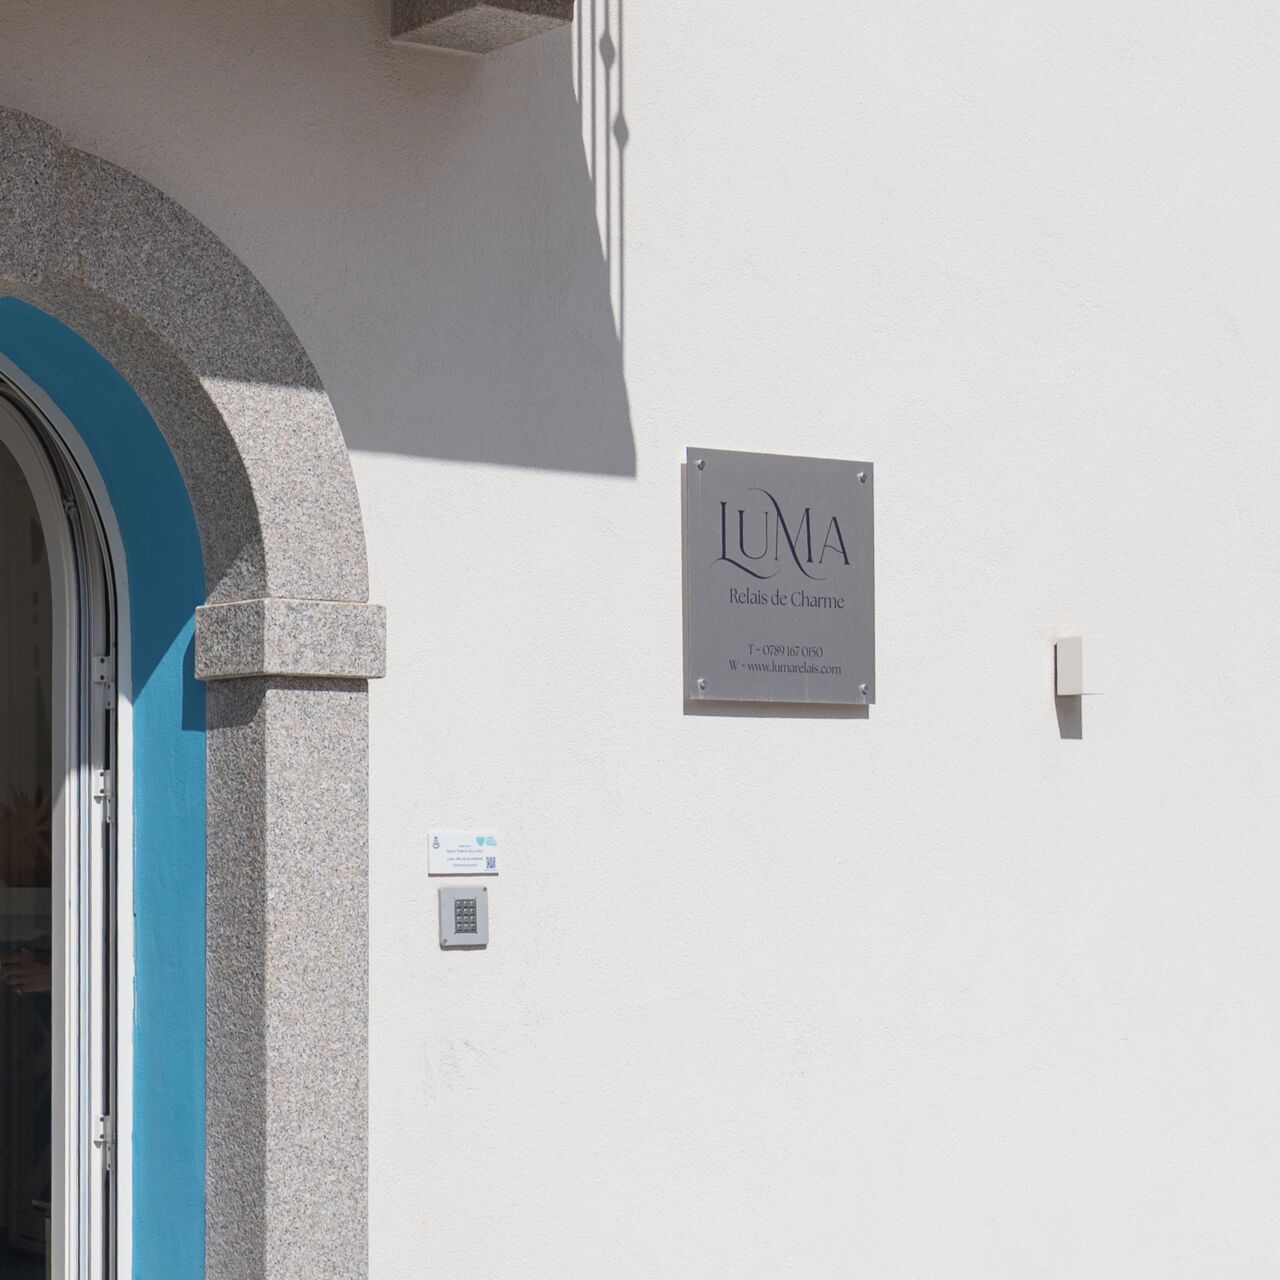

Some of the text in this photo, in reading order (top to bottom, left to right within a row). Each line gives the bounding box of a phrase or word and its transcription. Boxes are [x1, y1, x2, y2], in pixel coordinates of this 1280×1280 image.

[709, 487, 850, 581] LUMA
[729, 587, 845, 609] Relais de Charme
[747, 643, 754, 656] T
[762, 644, 785, 656] 0789
[787, 645, 800, 657] 167
[801, 646, 824, 658] 0150
[729, 659, 739, 671] W
[747, 659, 842, 675] www.lumarelais.com
